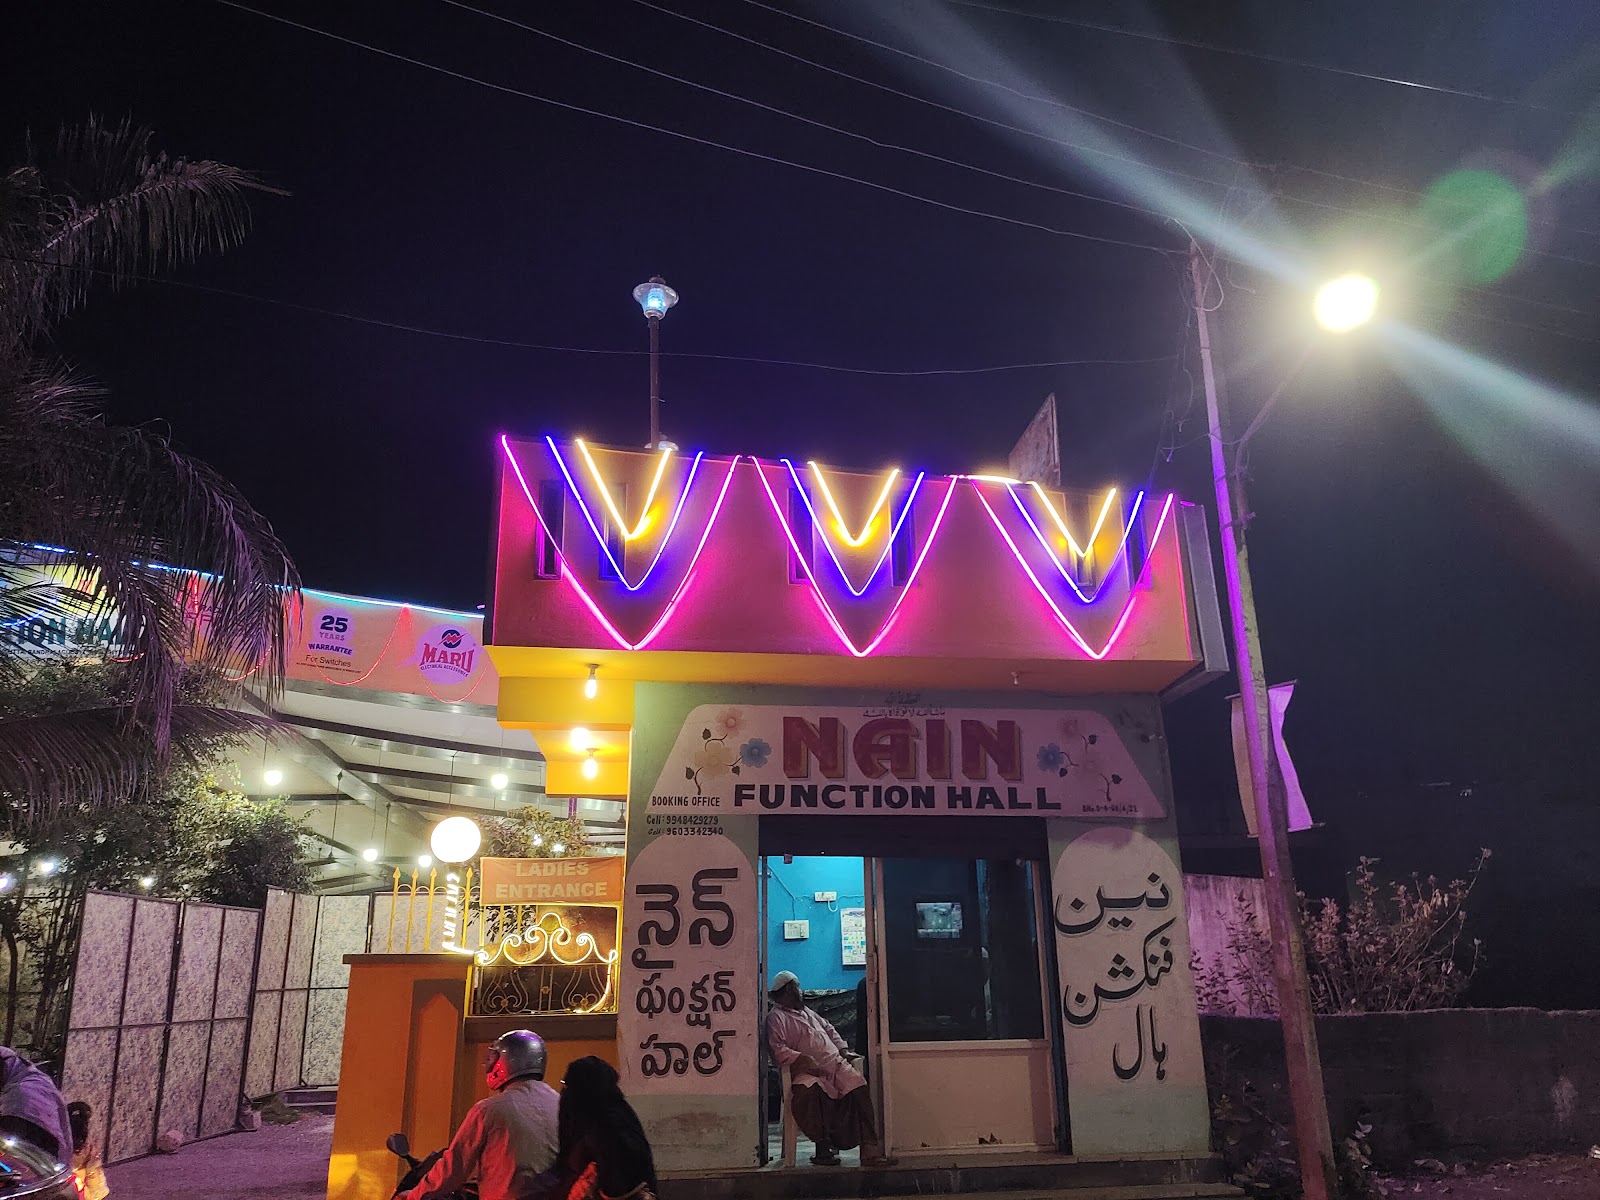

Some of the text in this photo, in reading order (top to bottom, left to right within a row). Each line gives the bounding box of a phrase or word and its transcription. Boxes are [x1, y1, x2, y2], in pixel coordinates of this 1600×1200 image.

[320, 615, 348, 632] 25
[319, 632, 345, 641] YEARS
[308, 643, 353, 655] WARRANTEE
[305, 654, 318, 663] For
[319, 656, 352, 668] Switches
[419, 643, 475, 673] MARU
[782, 716, 1023, 780] NAIN
[651, 795, 721, 807] BOOKING OFFICE
[734, 783, 1062, 811] FUNCTION HALL
[515, 861, 589, 877] LADIES
[495, 881, 608, 899] ENTRANCE
